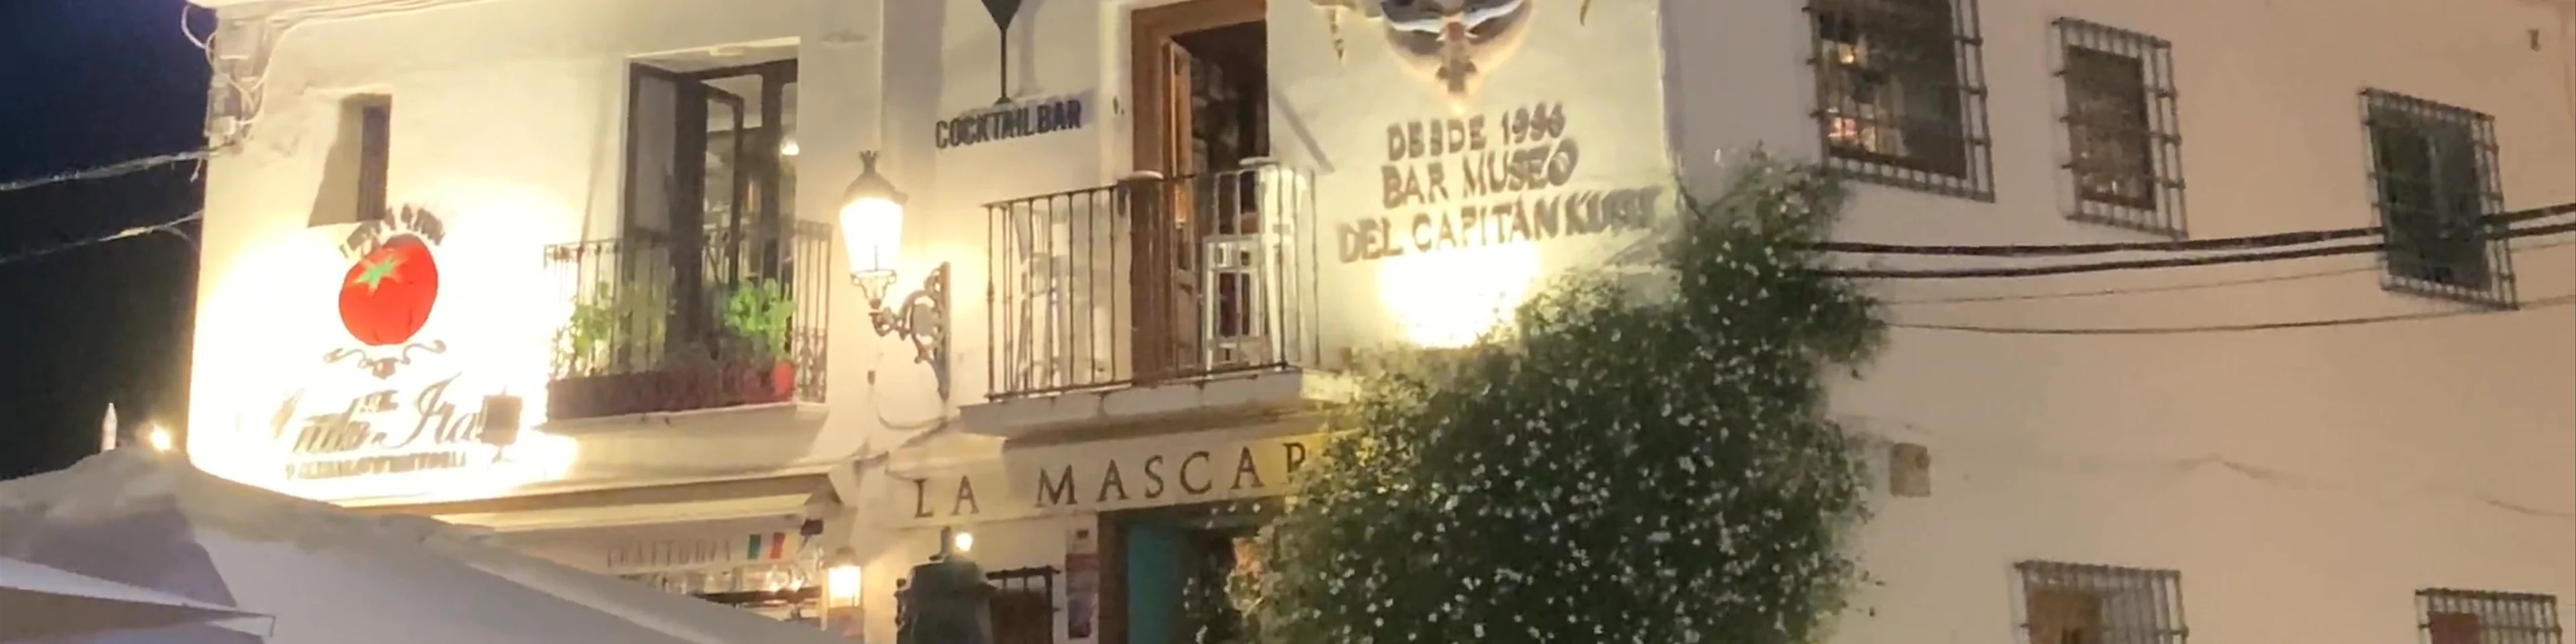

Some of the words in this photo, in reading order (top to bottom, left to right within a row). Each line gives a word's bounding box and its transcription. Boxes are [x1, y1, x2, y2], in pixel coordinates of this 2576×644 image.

[935, 107, 1034, 149] COCKTAIL
[1037, 99, 1082, 134] BAR
[1381, 162, 1449, 209] BAR
[1462, 138, 1578, 199] MUSEO
[1336, 216, 1404, 264] DEL
[913, 474, 980, 518] LA
